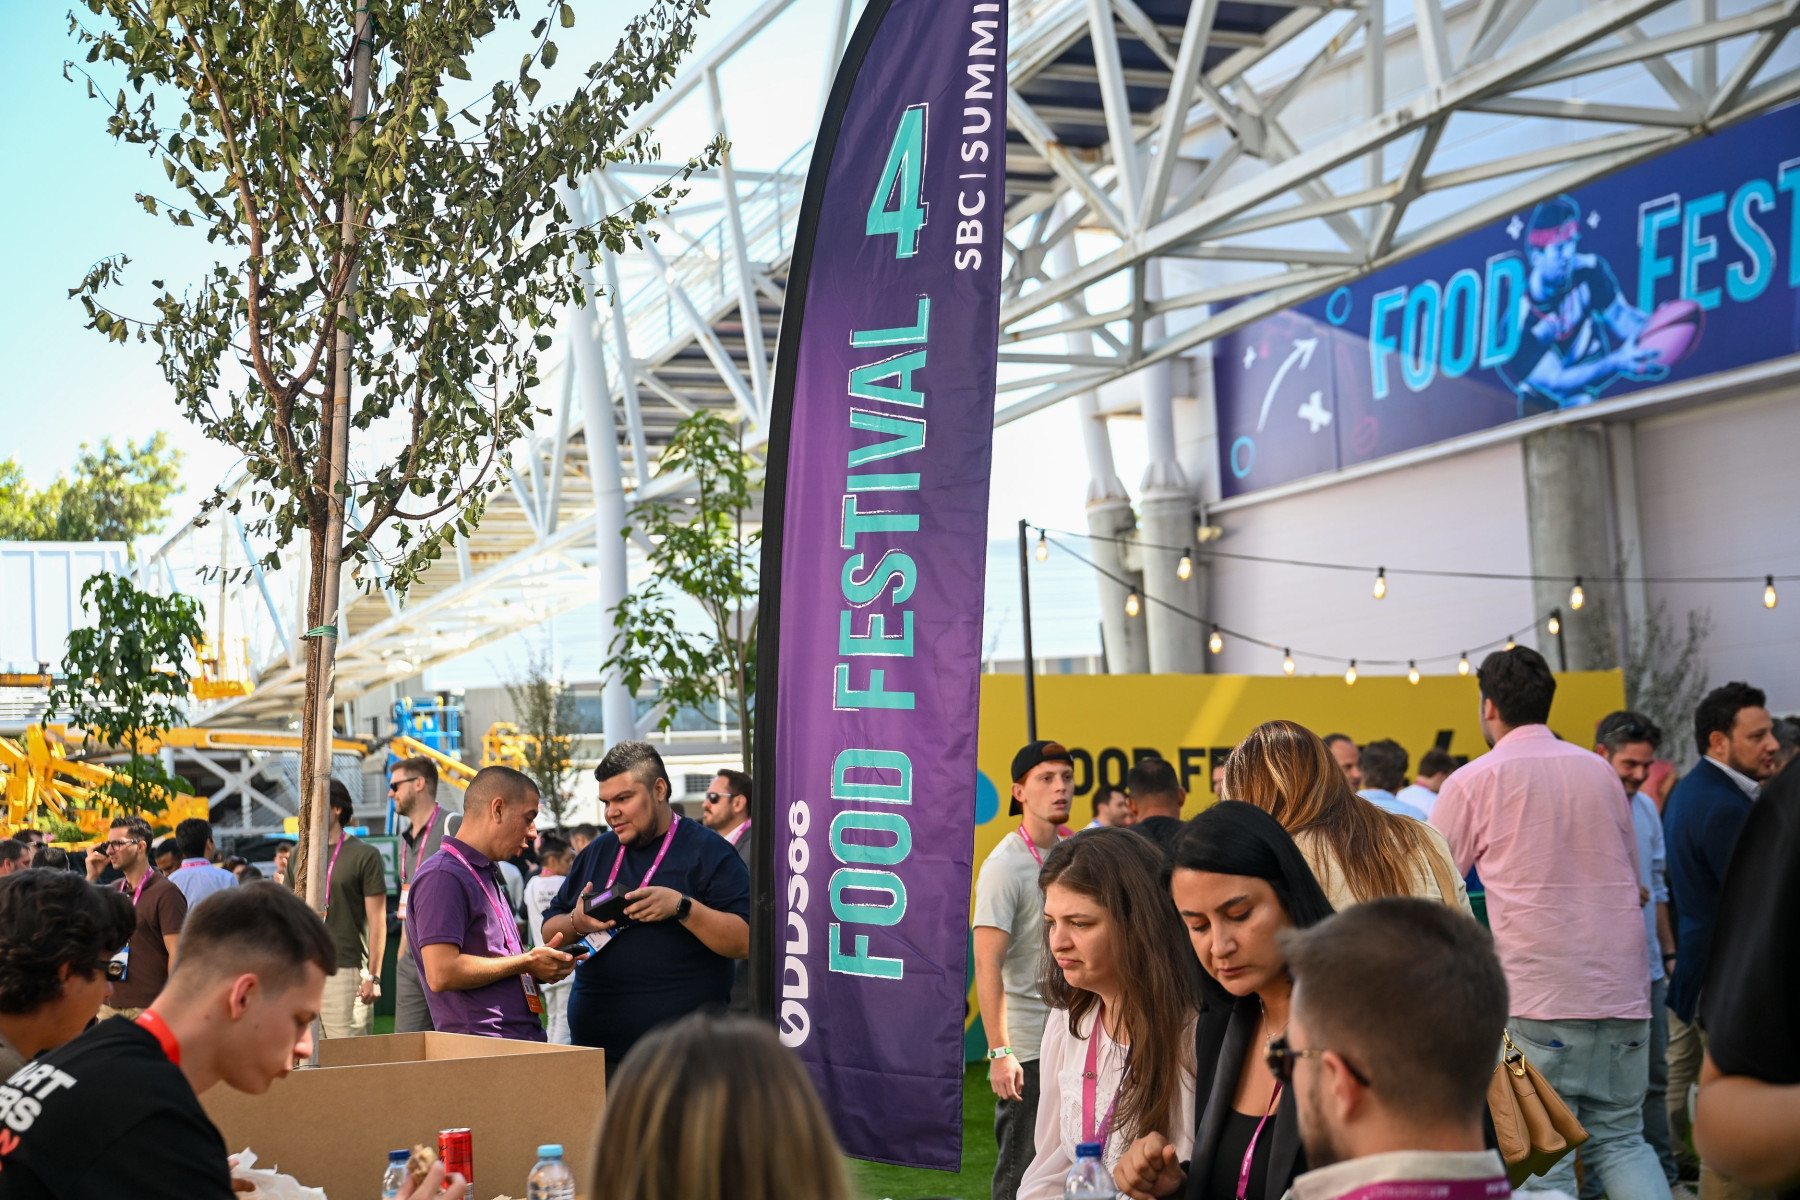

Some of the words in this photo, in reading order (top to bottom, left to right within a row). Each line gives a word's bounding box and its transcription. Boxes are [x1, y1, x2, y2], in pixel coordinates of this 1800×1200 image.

[866, 102, 929, 259] 4
[1369, 250, 1527, 400] FOOD
[832, 293, 931, 711] FESTIVAL
[828, 748, 913, 980] FOOD
